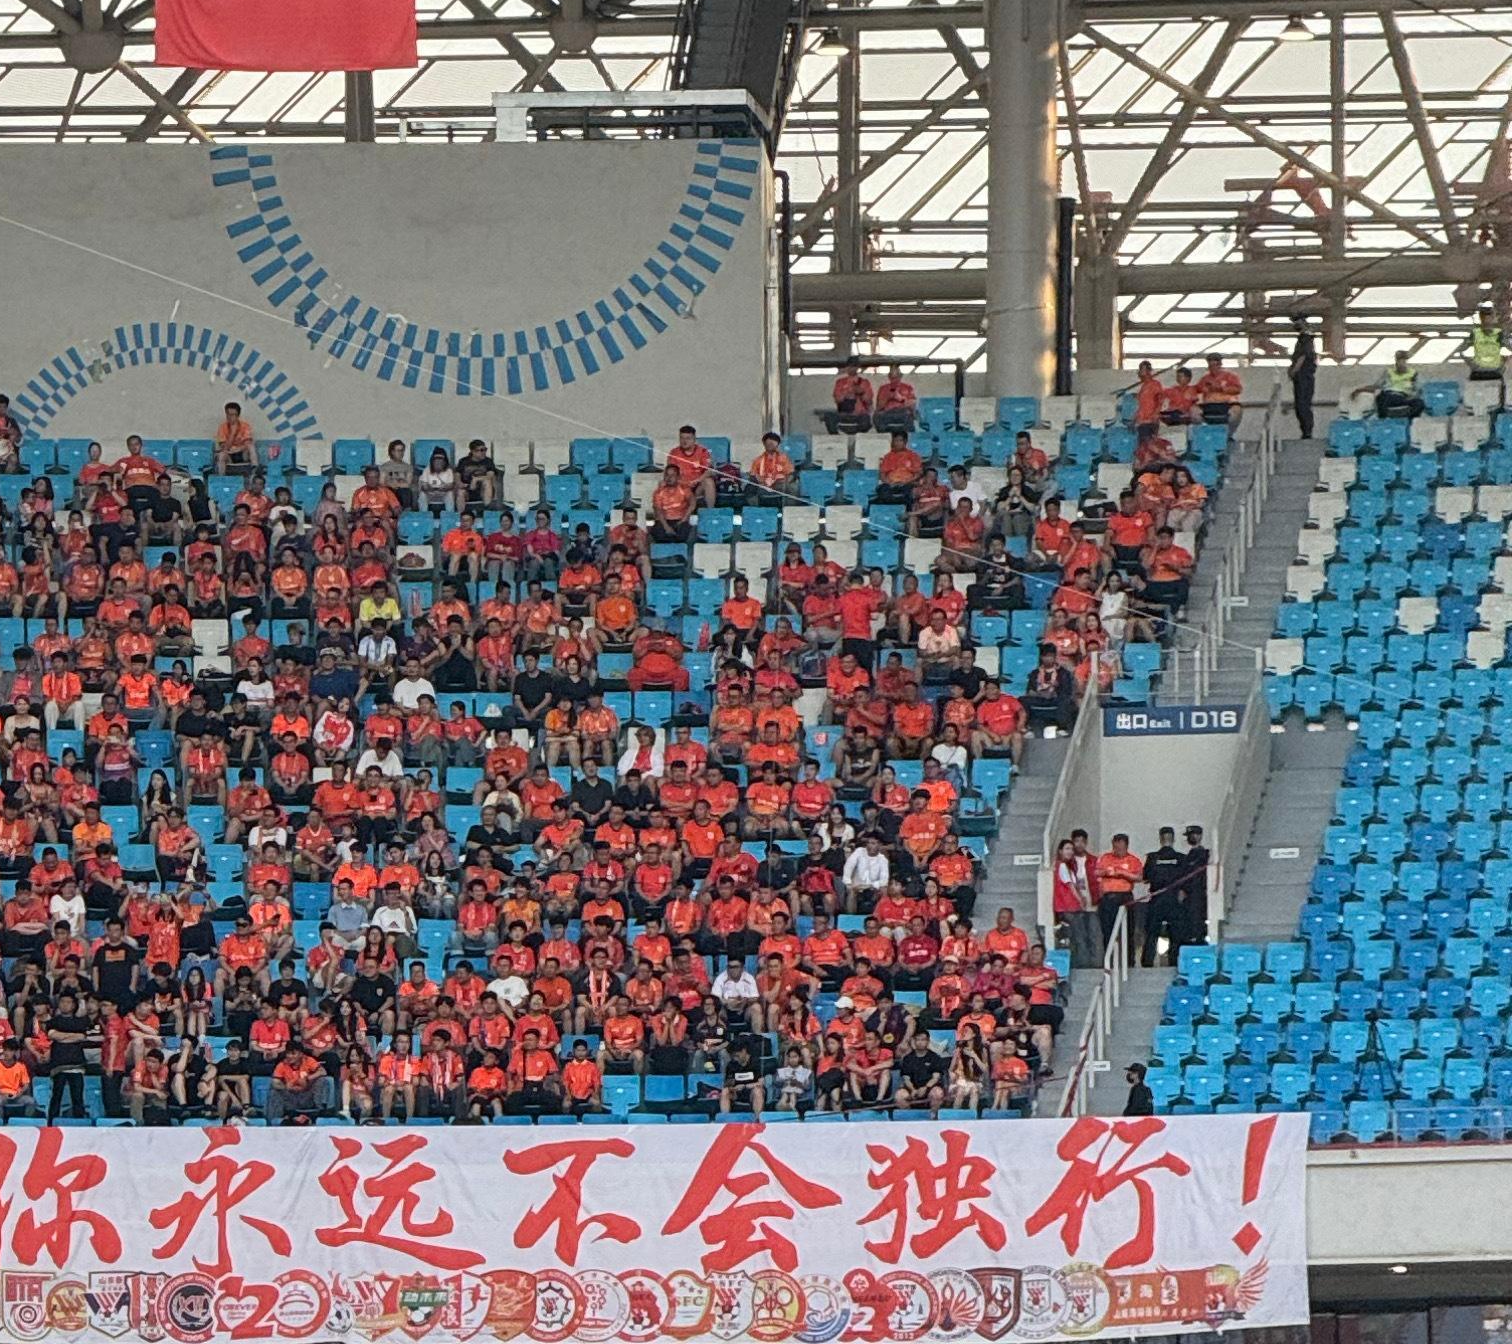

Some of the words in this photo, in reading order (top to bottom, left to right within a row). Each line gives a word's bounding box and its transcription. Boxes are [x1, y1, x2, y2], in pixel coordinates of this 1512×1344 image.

[1116, 713, 1147, 730] 出口
[1149, 719, 1172, 729] Exit
[1191, 711, 1237, 729] D16
